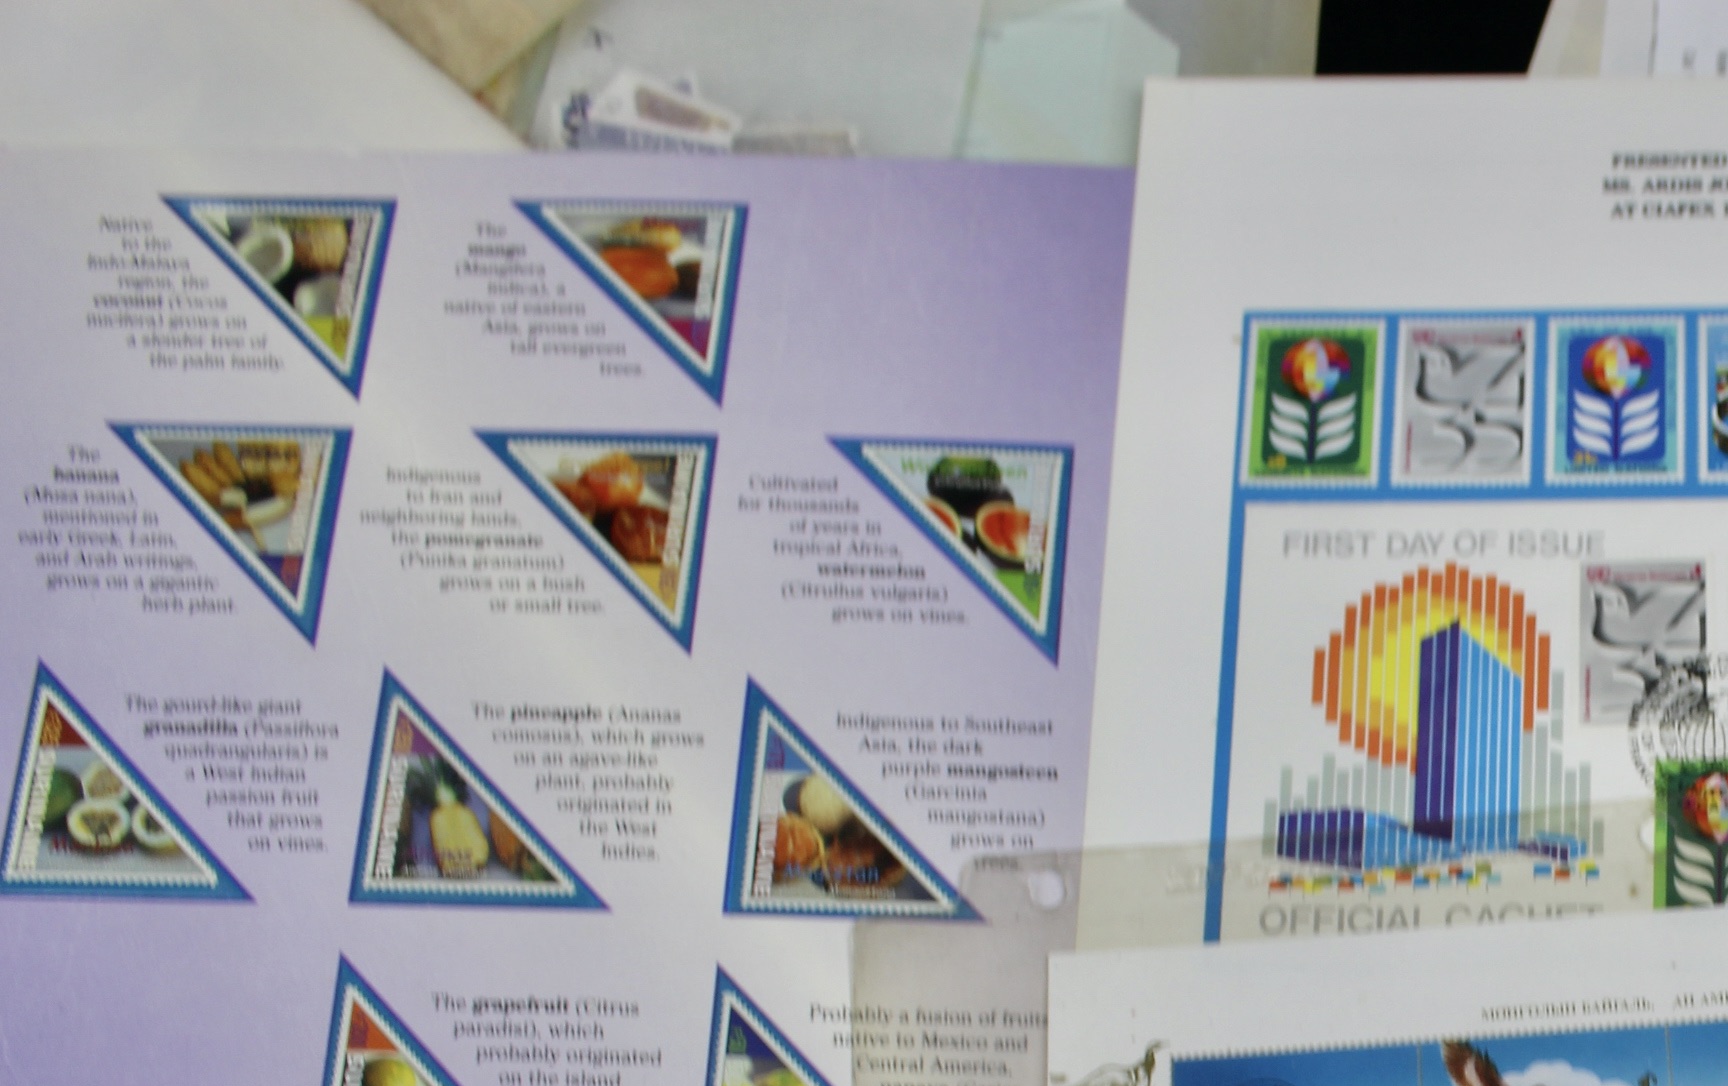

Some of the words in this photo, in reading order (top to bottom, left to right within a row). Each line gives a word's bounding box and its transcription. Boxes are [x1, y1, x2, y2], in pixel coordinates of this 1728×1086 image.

[1612, 201, 1635, 218] AT
[1282, 528, 1375, 559] FIRST
[1386, 528, 1445, 558] DAY
[1453, 528, 1498, 558] OF
[1509, 528, 1606, 558] ISSUE
[1257, 900, 1422, 937] OFFICIAL
